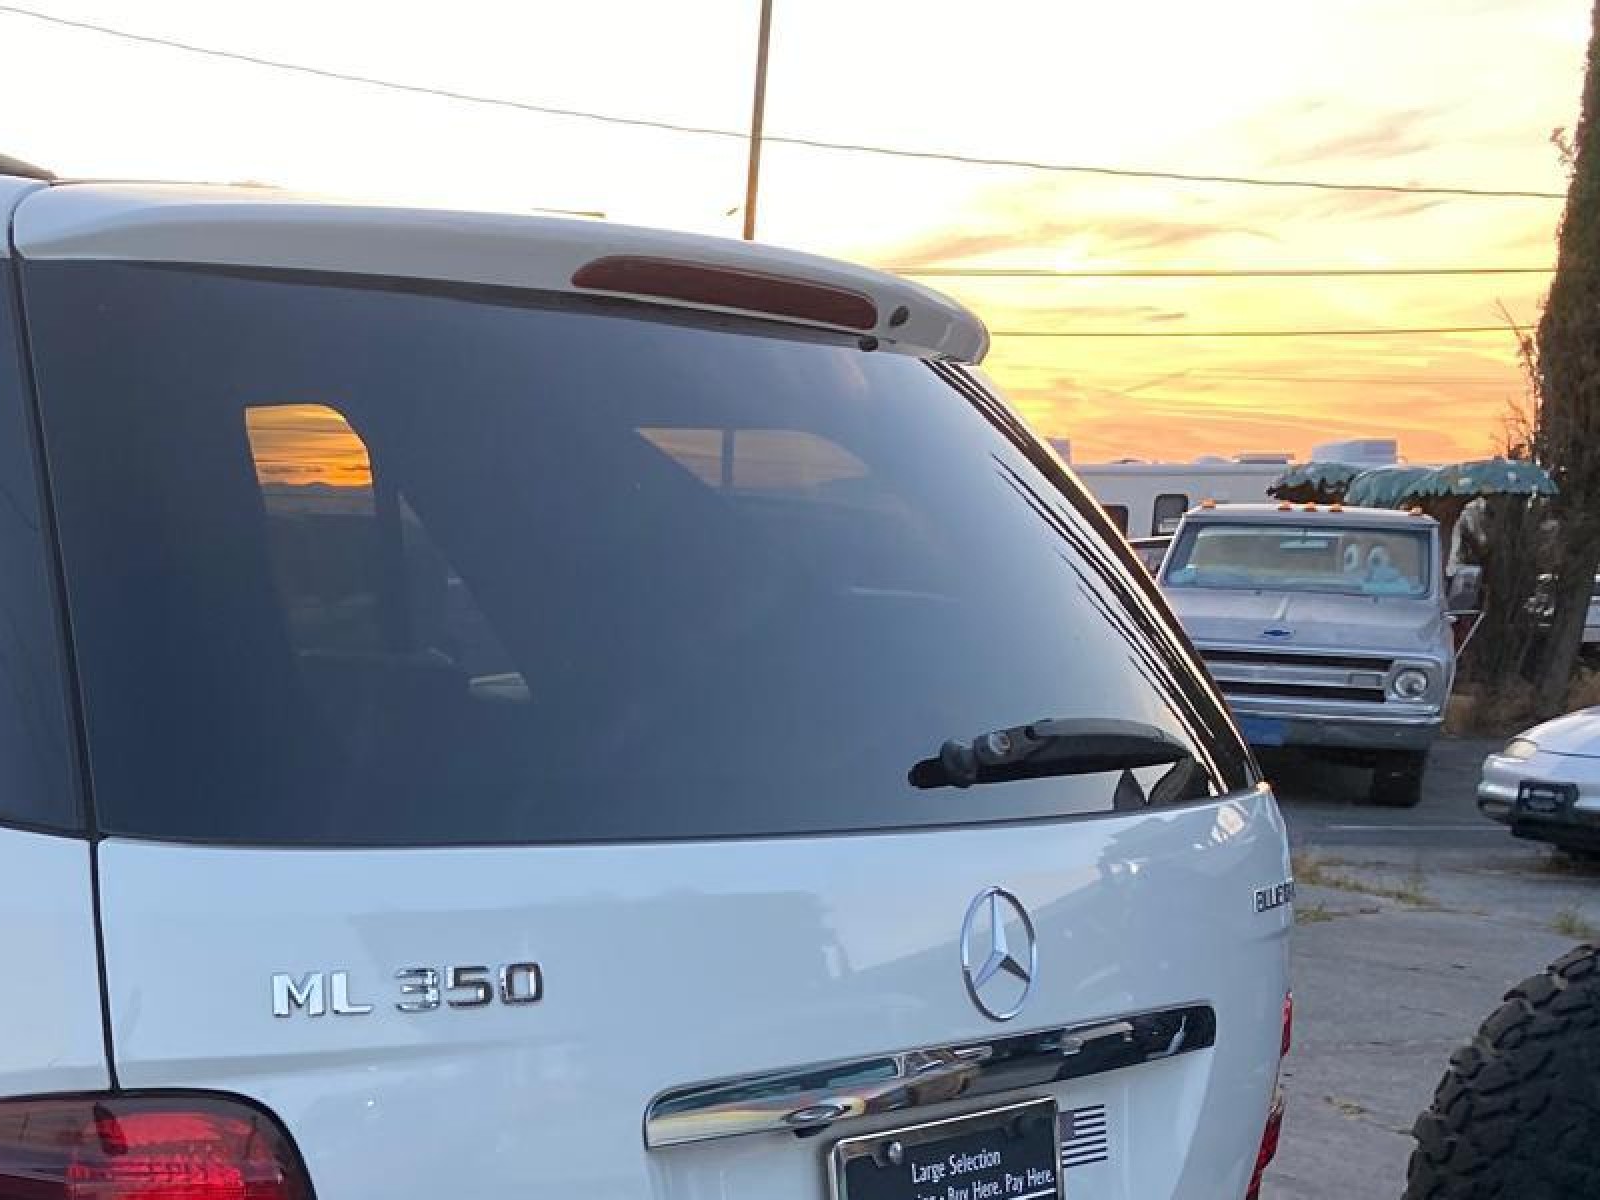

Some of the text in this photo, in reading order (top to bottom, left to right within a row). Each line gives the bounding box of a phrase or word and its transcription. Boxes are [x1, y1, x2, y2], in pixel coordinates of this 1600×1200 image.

[271, 961, 544, 1018] ML 350
[911, 1147, 1001, 1184] Large Selection
[1005, 1173, 1024, 1194] Pay
